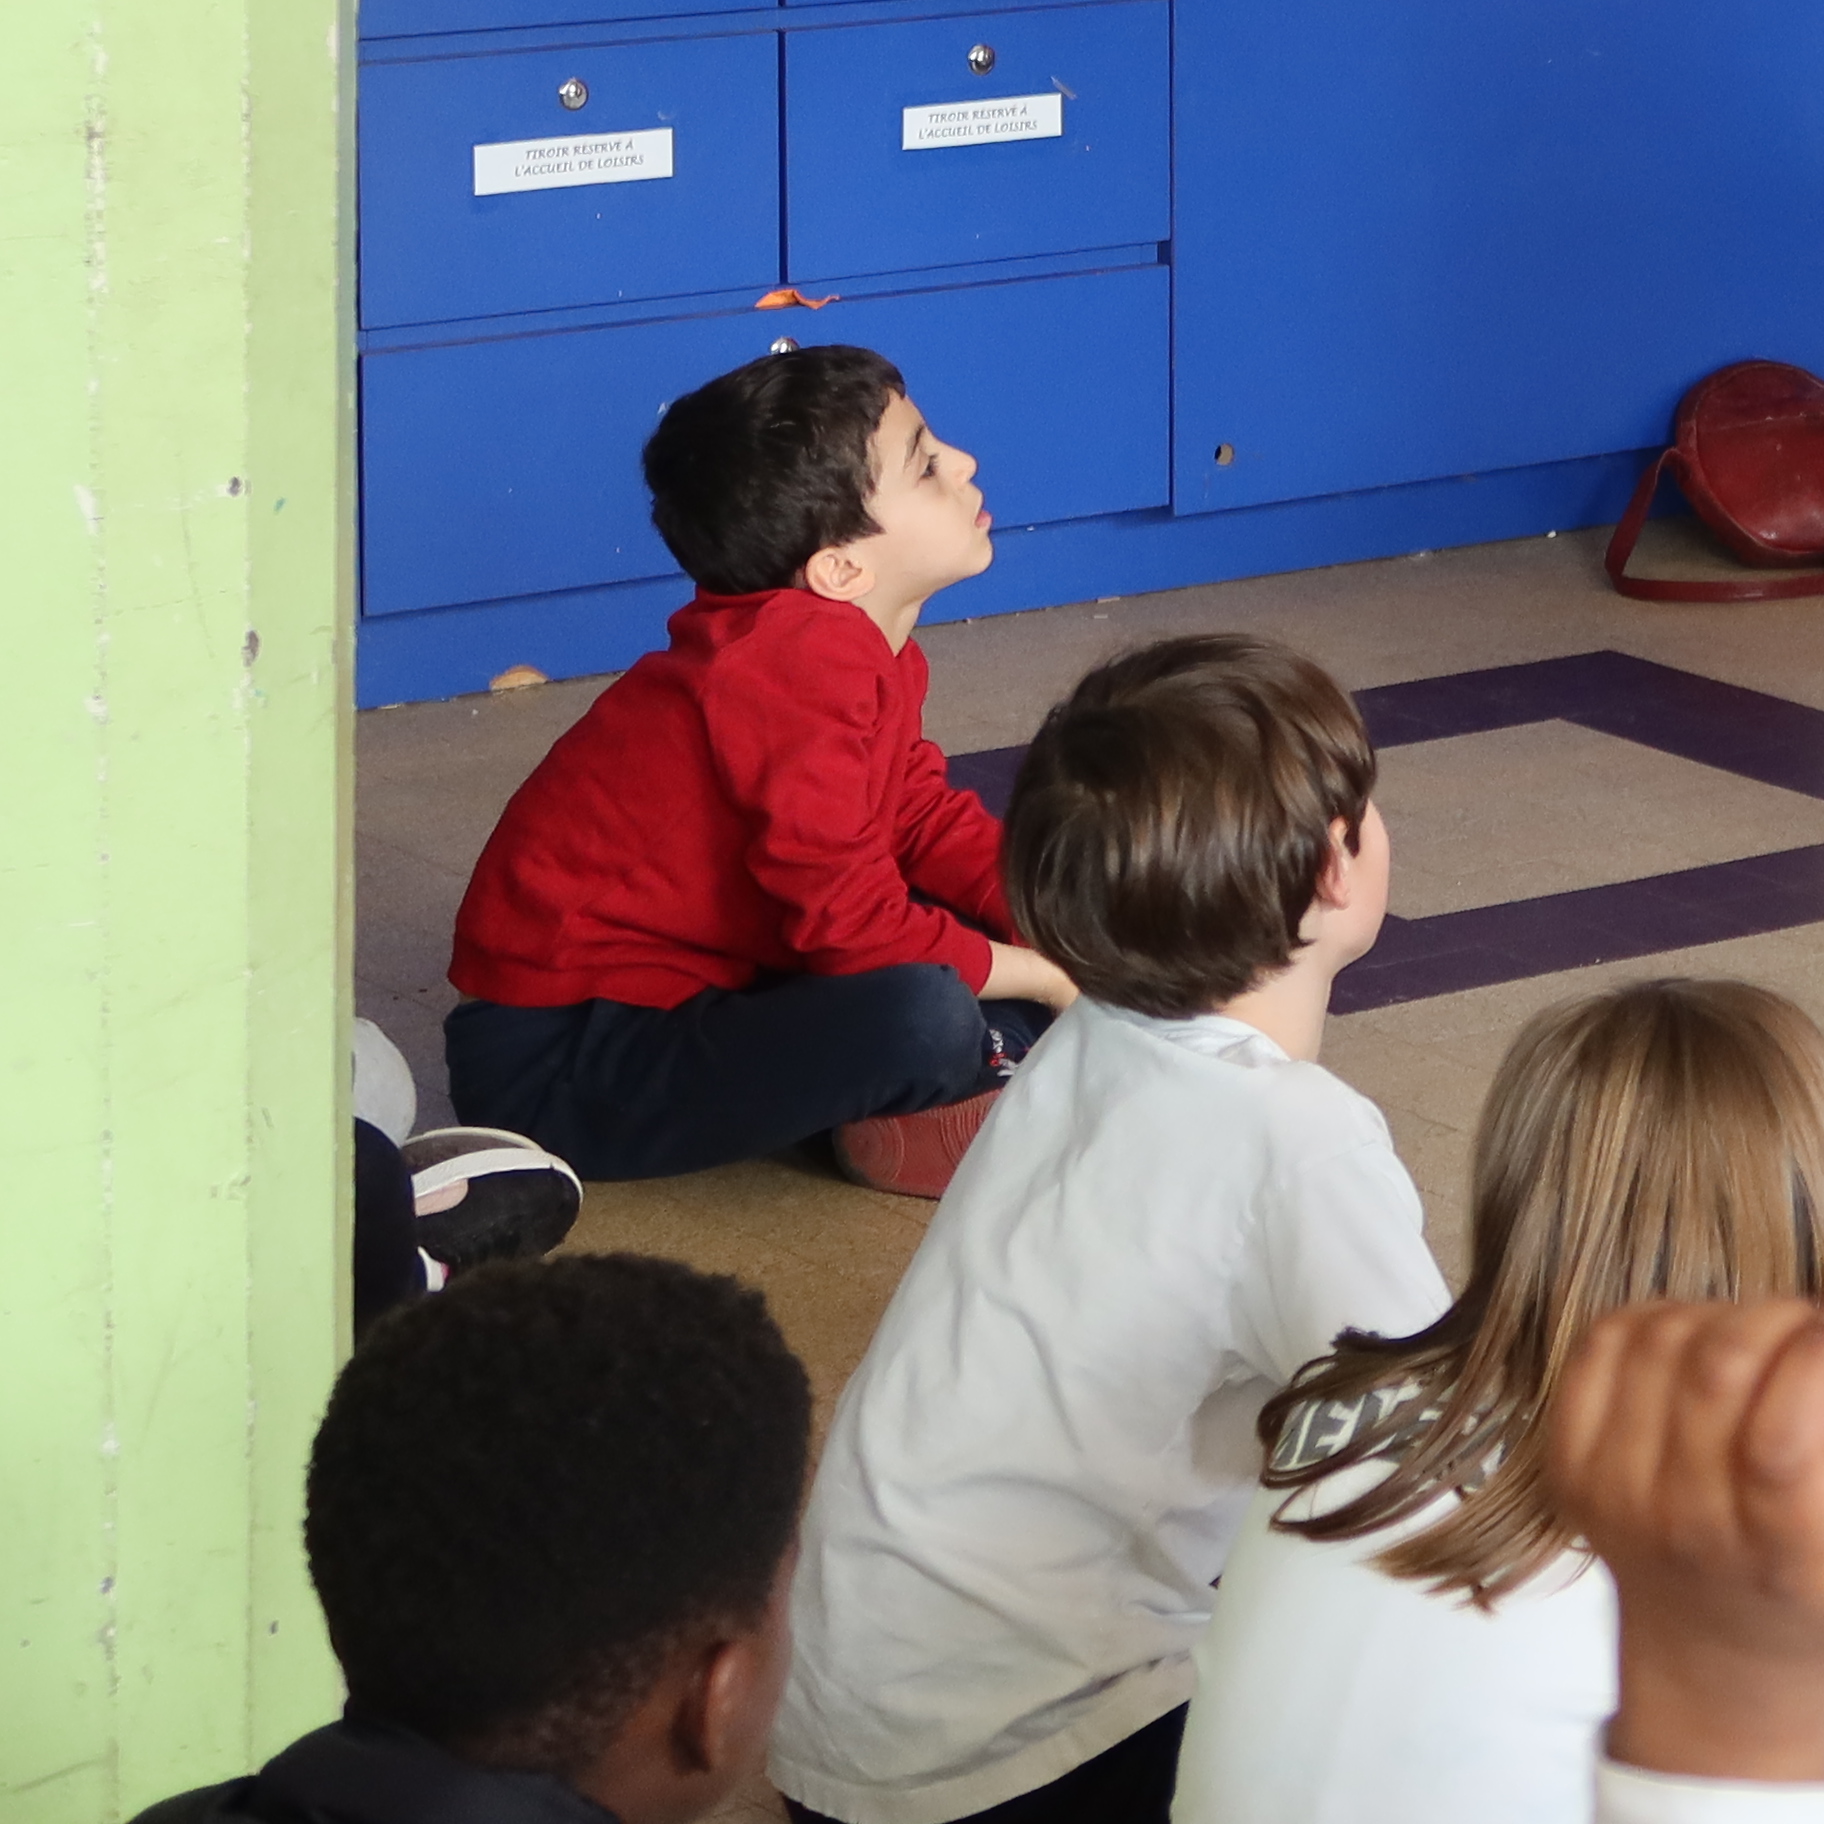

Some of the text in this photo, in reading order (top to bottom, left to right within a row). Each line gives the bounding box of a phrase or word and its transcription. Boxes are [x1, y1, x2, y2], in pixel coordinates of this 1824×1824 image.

[928, 110, 969, 124] TIROIR
[918, 120, 1038, 139] L'ACCUEIL DE LOISIRS
[525, 146, 570, 161] TIROIR
[514, 154, 645, 178] L'ACCUEIL DE LOISIRS
